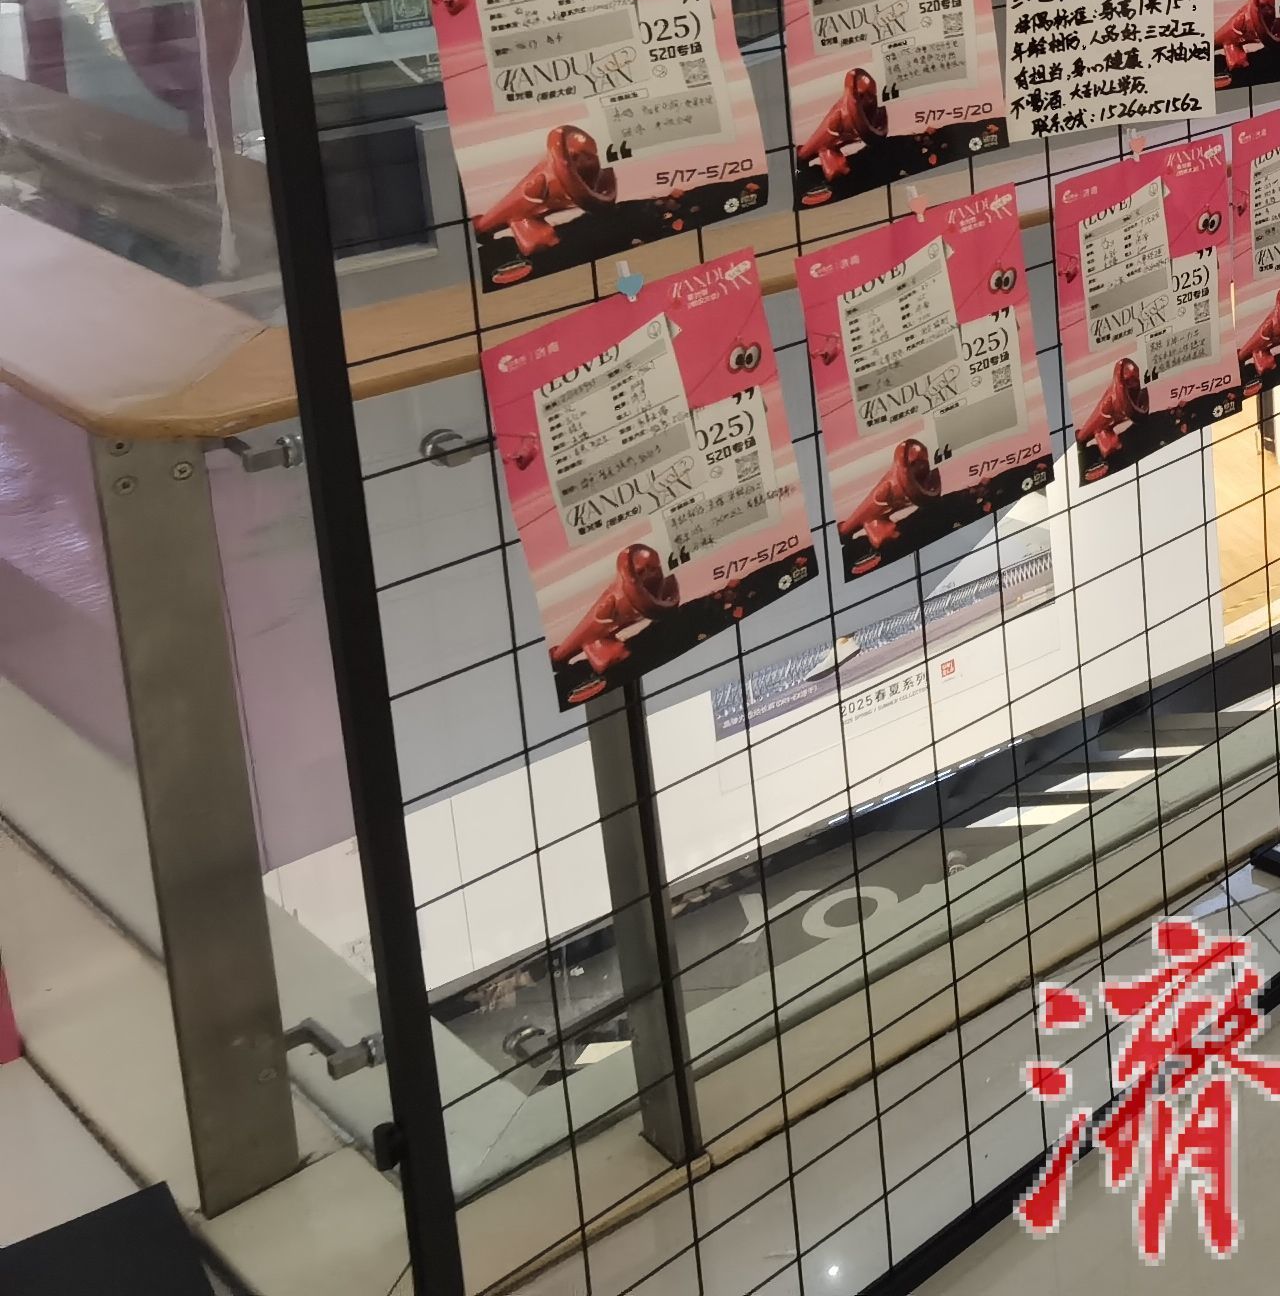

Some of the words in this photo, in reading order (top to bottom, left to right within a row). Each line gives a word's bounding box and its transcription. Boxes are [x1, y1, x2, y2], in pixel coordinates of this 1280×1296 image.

[915, 103, 993, 124] 5/17-5/20
[656, 158, 754, 187] 5/17-5/20
[1170, 374, 1232, 399] 5/17-5/20
[969, 443, 1041, 477] 5/17-5/20
[712, 535, 799, 580] 5/17-5/20
[841, 671, 927, 717] 2025春夏系列
